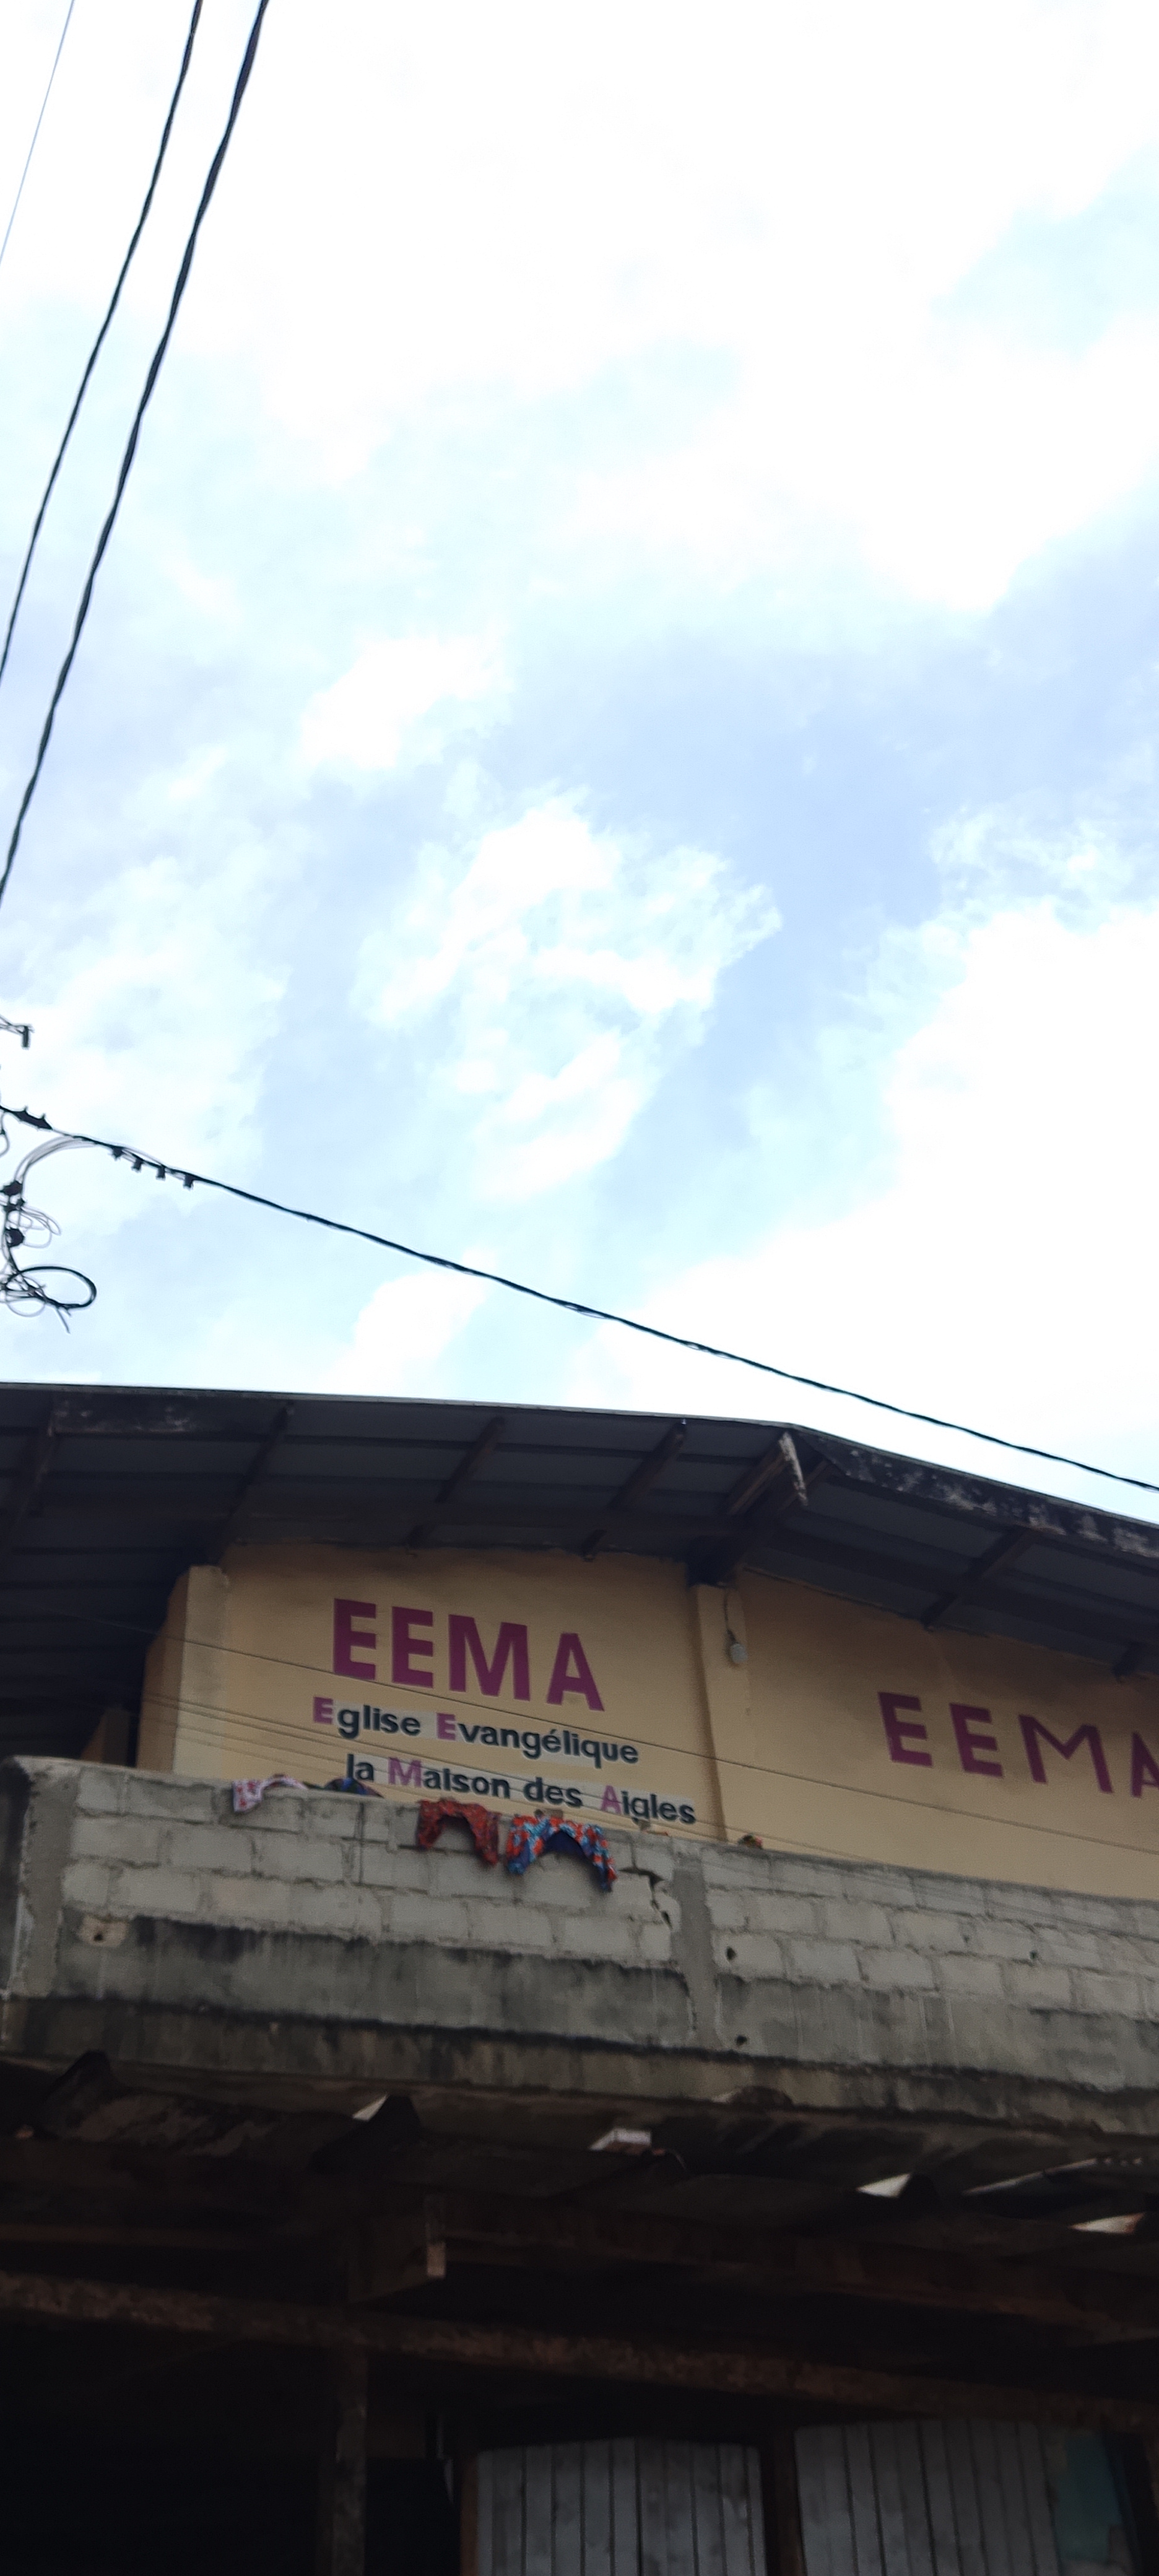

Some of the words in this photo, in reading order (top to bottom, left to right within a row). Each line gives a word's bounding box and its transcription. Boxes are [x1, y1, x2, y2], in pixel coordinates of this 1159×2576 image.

[332, 1598, 606, 1712] EEMA
[313, 1696, 422, 1740] Eglise
[436, 1712, 640, 1769] Evangélique
[877, 1692, 1159, 1798] EEMA
[346, 1753, 375, 1782] la
[388, 1757, 510, 1798] Maison
[523, 1776, 583, 1807] des
[601, 1785, 696, 1825] Aigles
